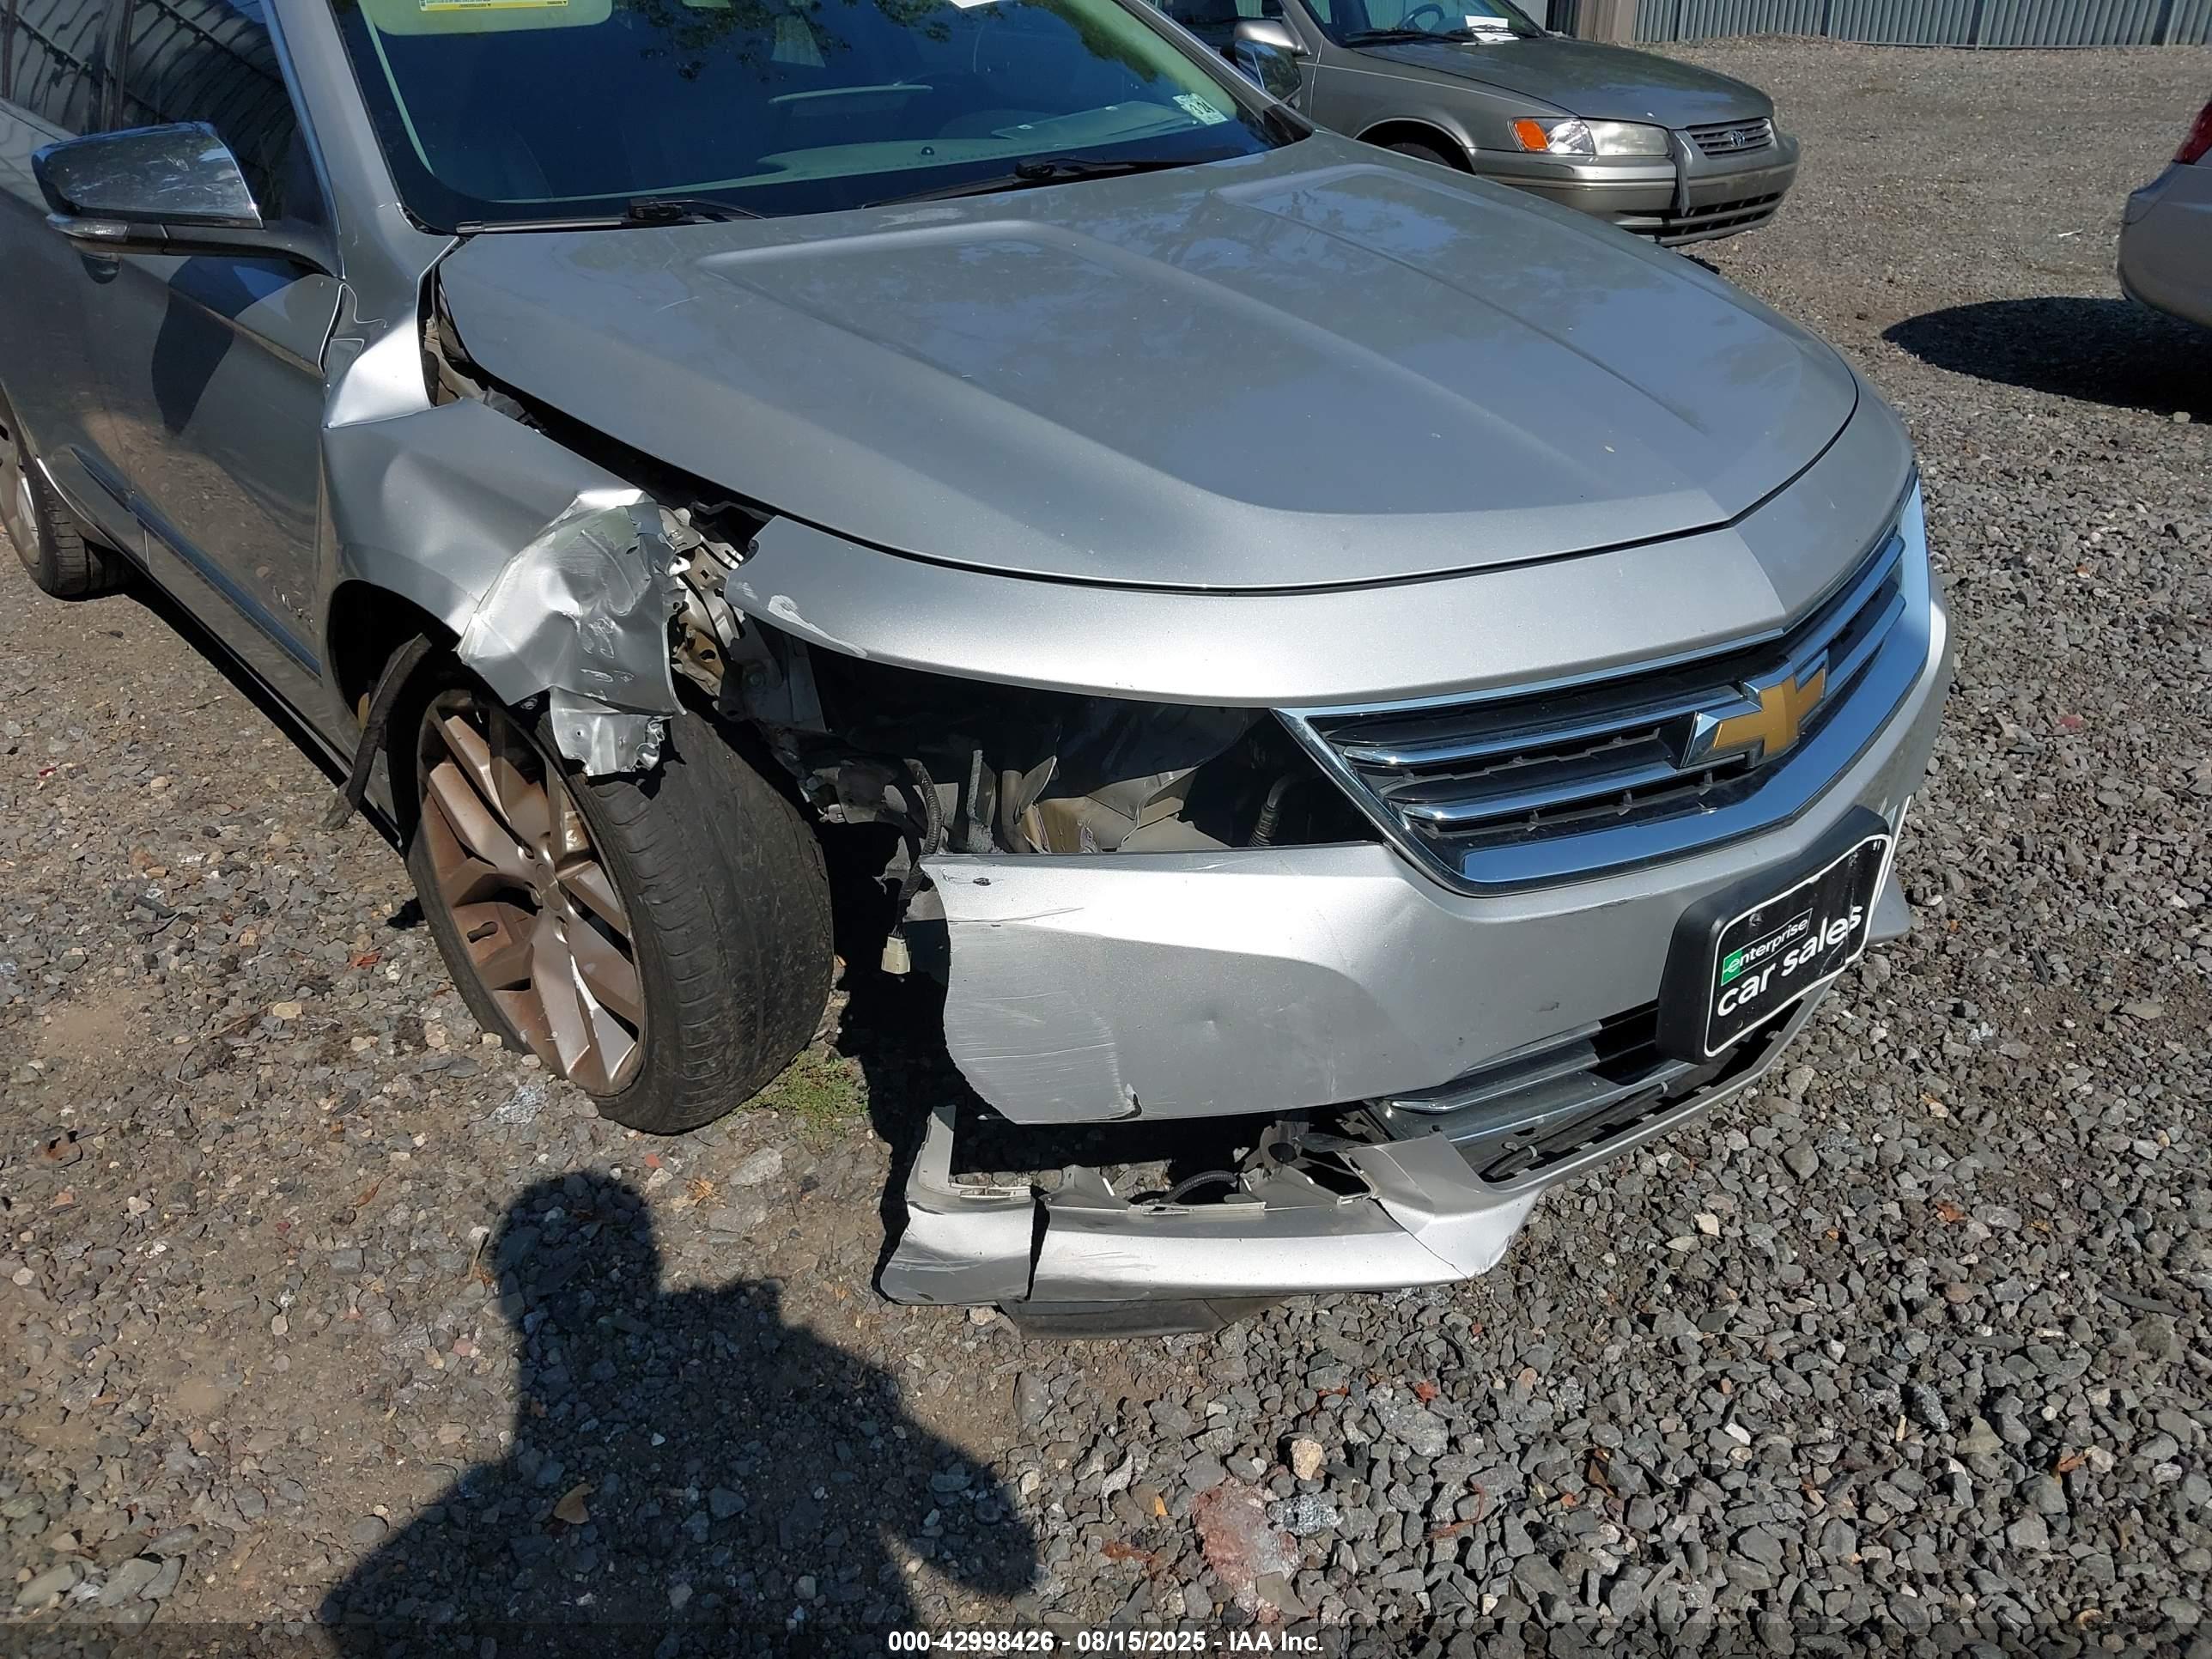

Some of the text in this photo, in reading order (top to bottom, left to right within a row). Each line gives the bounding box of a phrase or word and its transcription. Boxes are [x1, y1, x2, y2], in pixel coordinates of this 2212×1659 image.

[1718, 905, 1863, 1017] car sales
[1723, 917, 1808, 974] enterprise
